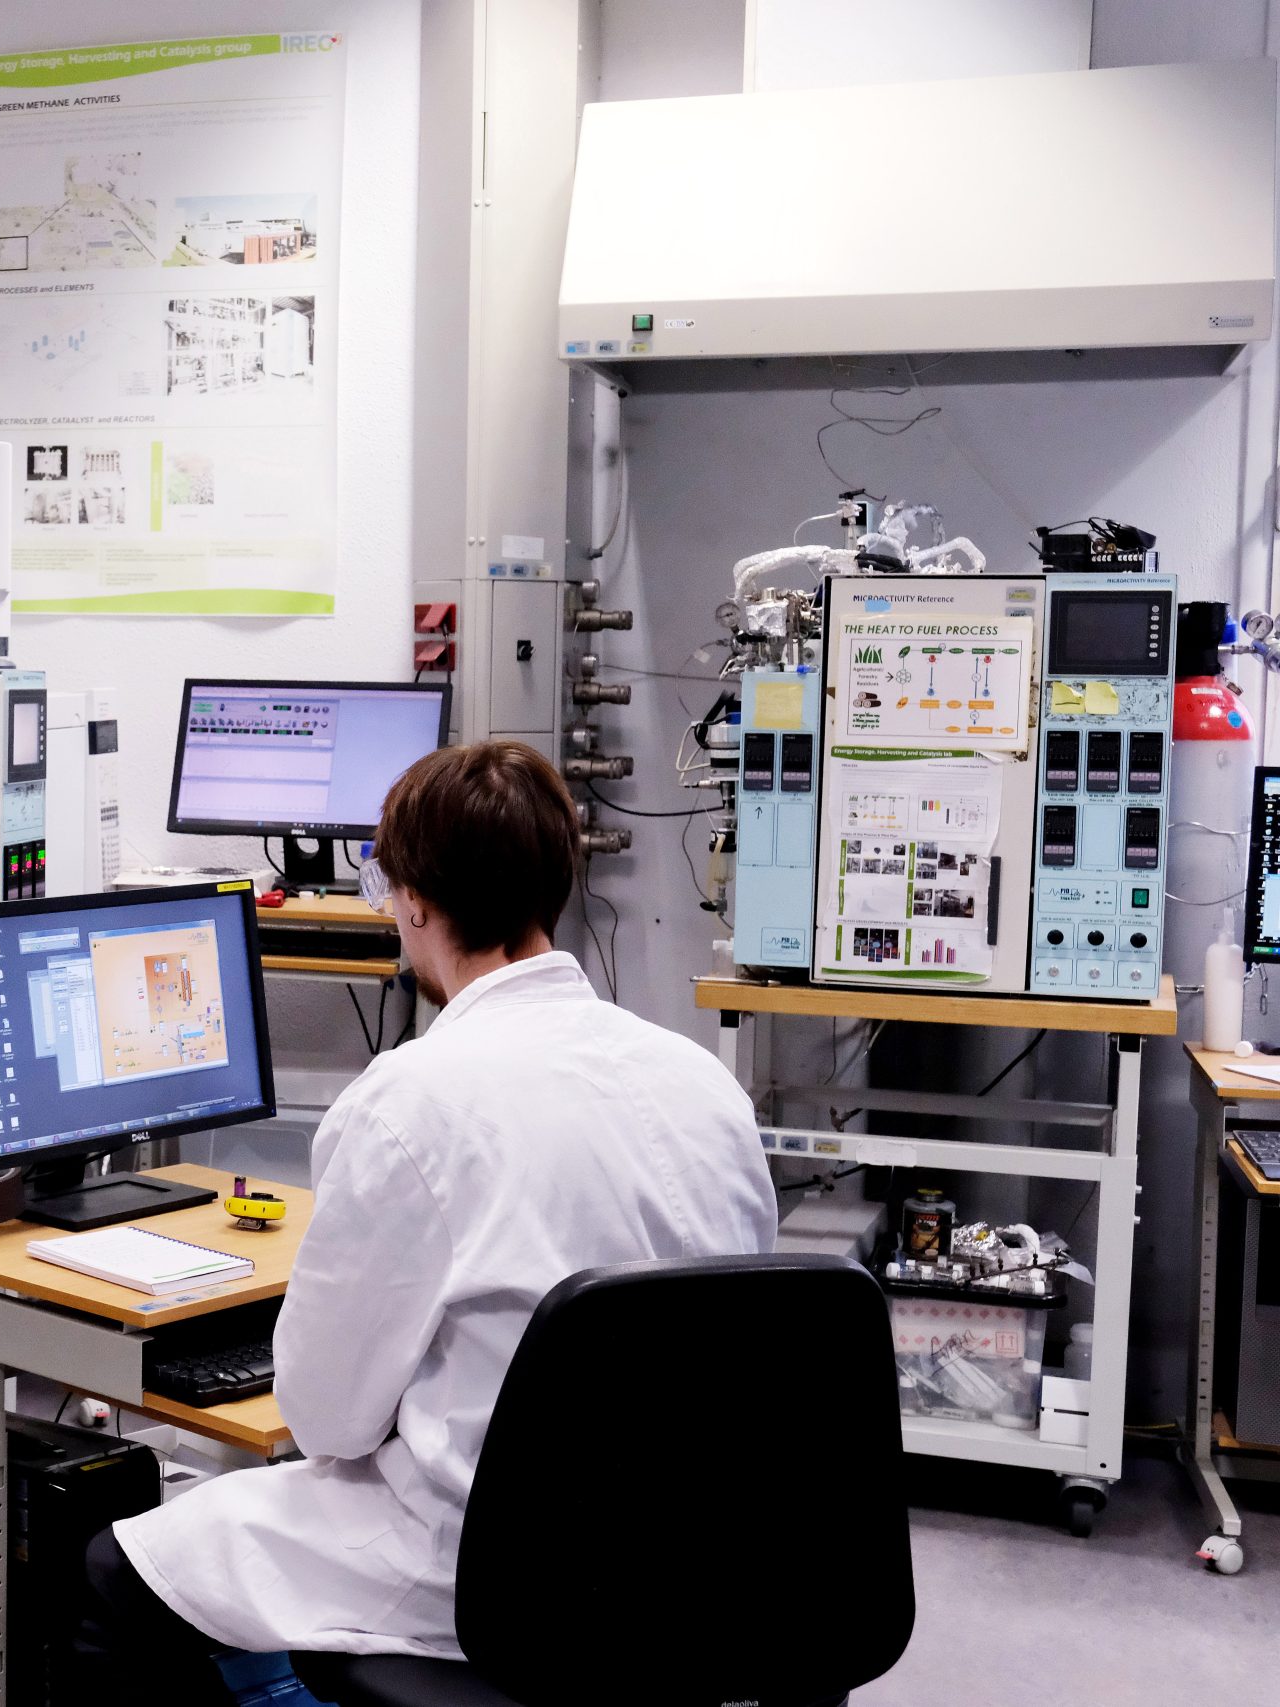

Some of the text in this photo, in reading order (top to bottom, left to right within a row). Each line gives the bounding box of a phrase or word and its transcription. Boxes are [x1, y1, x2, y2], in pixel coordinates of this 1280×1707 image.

[283, 34, 334, 53] IREC
[68, 47, 132, 67] Harvesting
[134, 45, 157, 60] and
[159, 43, 212, 59] Catalysis
[214, 40, 253, 57] group
[26, 97, 70, 111] METHANE
[73, 94, 121, 106] ACTIVITIES
[39, 285, 54, 295] and
[55, 283, 95, 293] ELEMENTS
[97, 415, 112, 425] and
[113, 414, 156, 424] REACTORS
[917, 595, 955, 603] Reference
[844, 624, 999, 636] THE HEAT TO FUEL PROCESS
[834, 747, 854, 756] Energy
[876, 749, 906, 758] Harvesting
[132, 1131, 150, 1143] DELL
